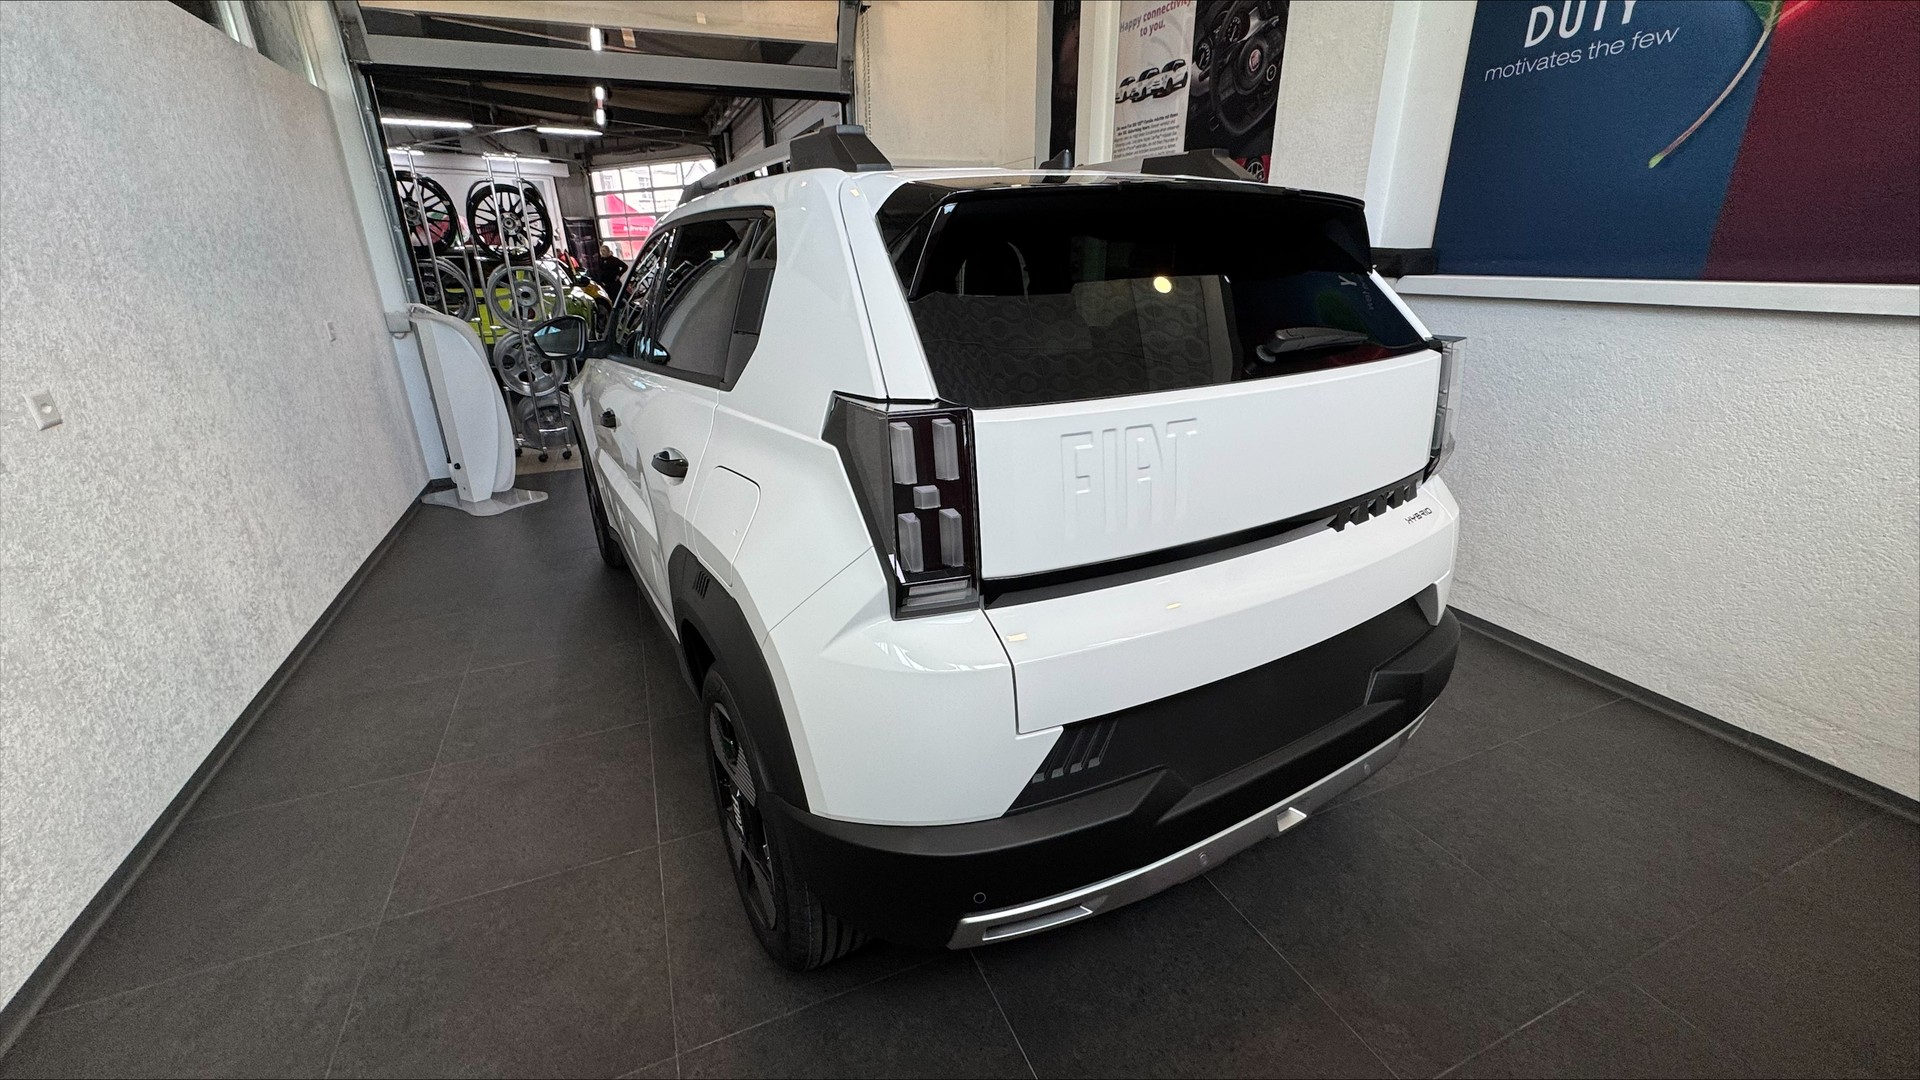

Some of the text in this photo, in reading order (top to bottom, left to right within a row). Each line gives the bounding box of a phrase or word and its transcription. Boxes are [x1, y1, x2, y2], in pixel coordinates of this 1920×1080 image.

[1120, 0, 1191, 32] Happy connectivity
[1140, 20, 1166, 37] to you.
[1484, 27, 1680, 82] motivates the few
[1060, 417, 1198, 536] FIAT
[1404, 507, 1433, 525] HYBRID
